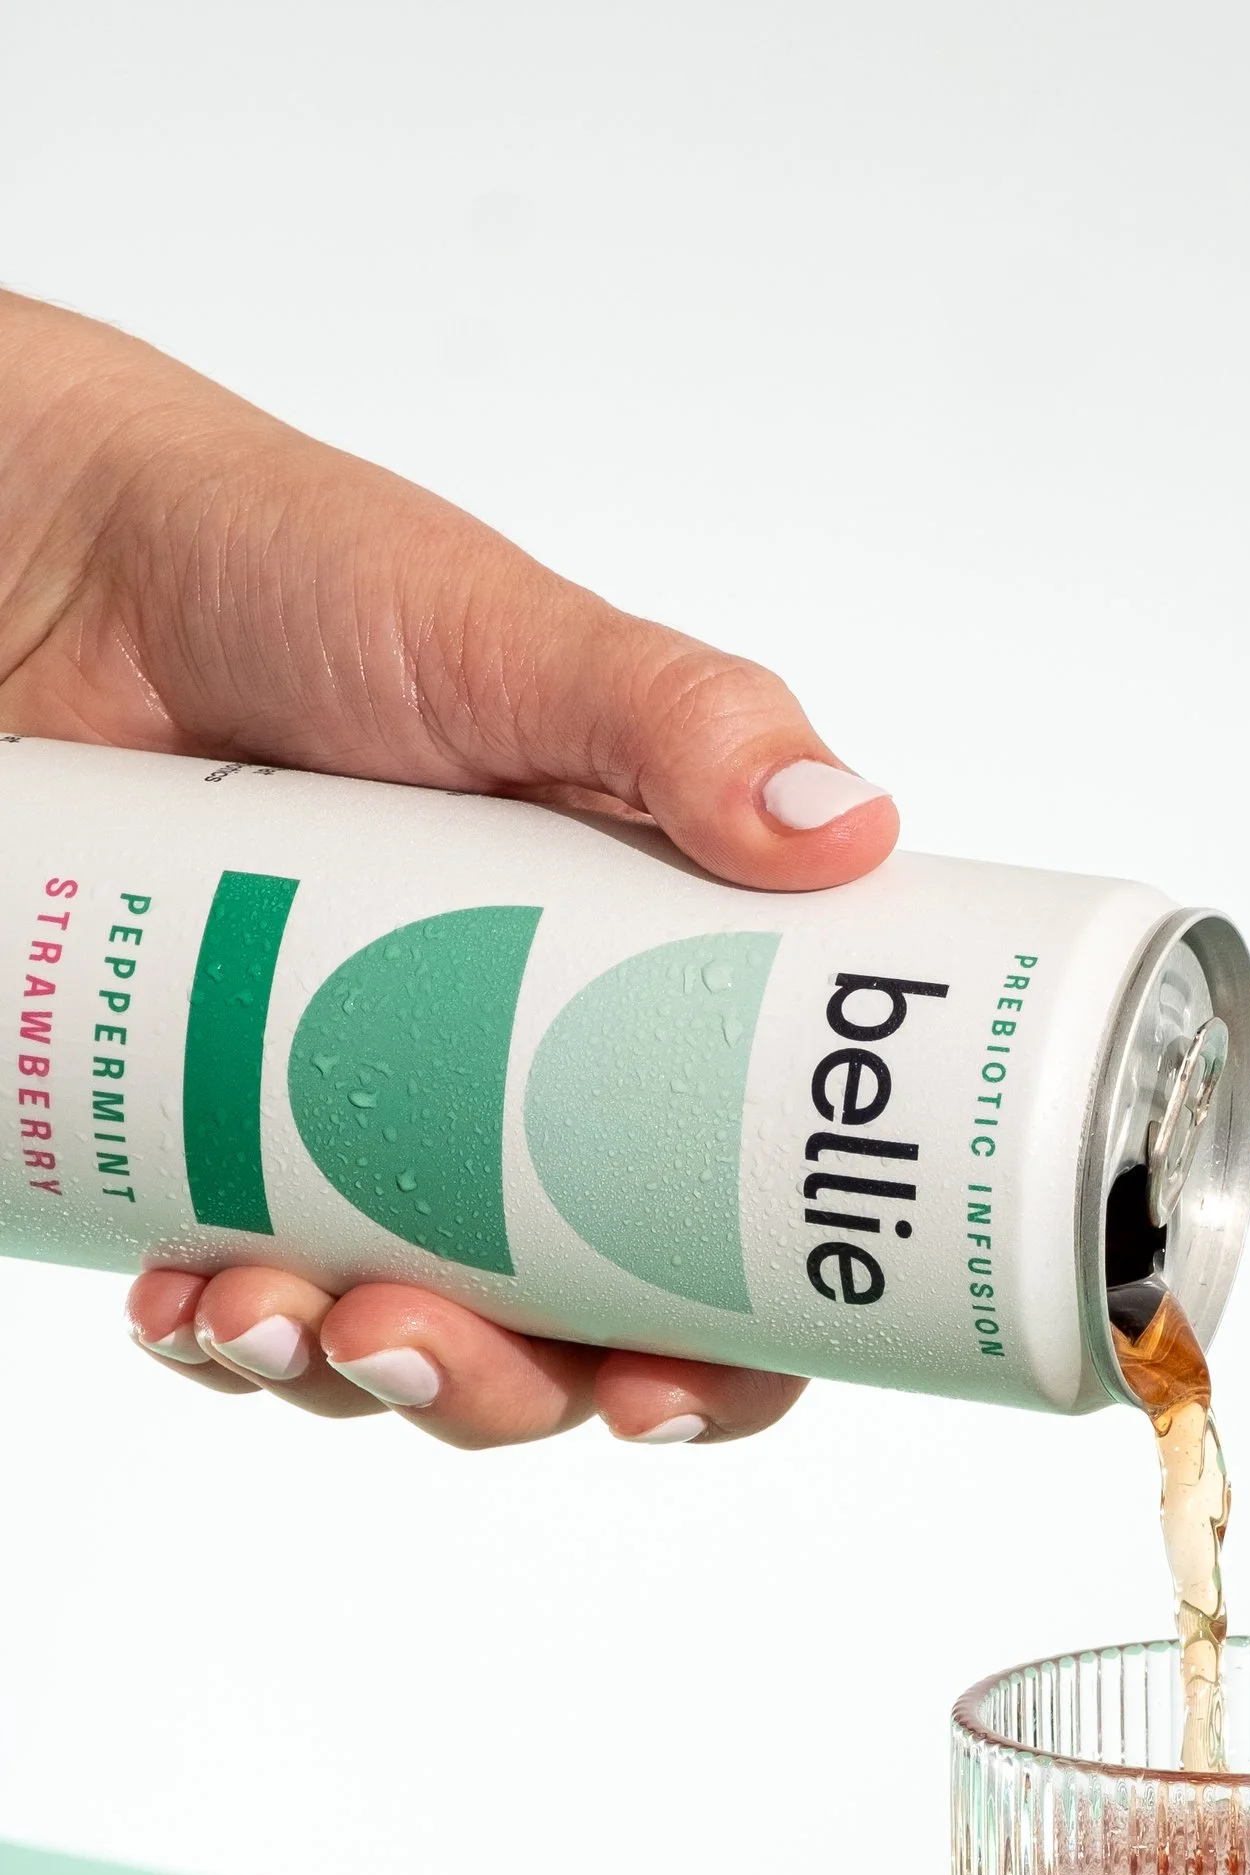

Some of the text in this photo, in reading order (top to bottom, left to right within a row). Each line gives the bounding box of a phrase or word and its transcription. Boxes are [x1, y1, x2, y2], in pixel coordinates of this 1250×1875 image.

[18, 877, 78, 1196] STRAWBERRY
[91, 892, 152, 1203] PEPPERMINT
[802, 971, 950, 1306] bellie
[966, 953, 1038, 1358] PREBIOTIC INFUSION
